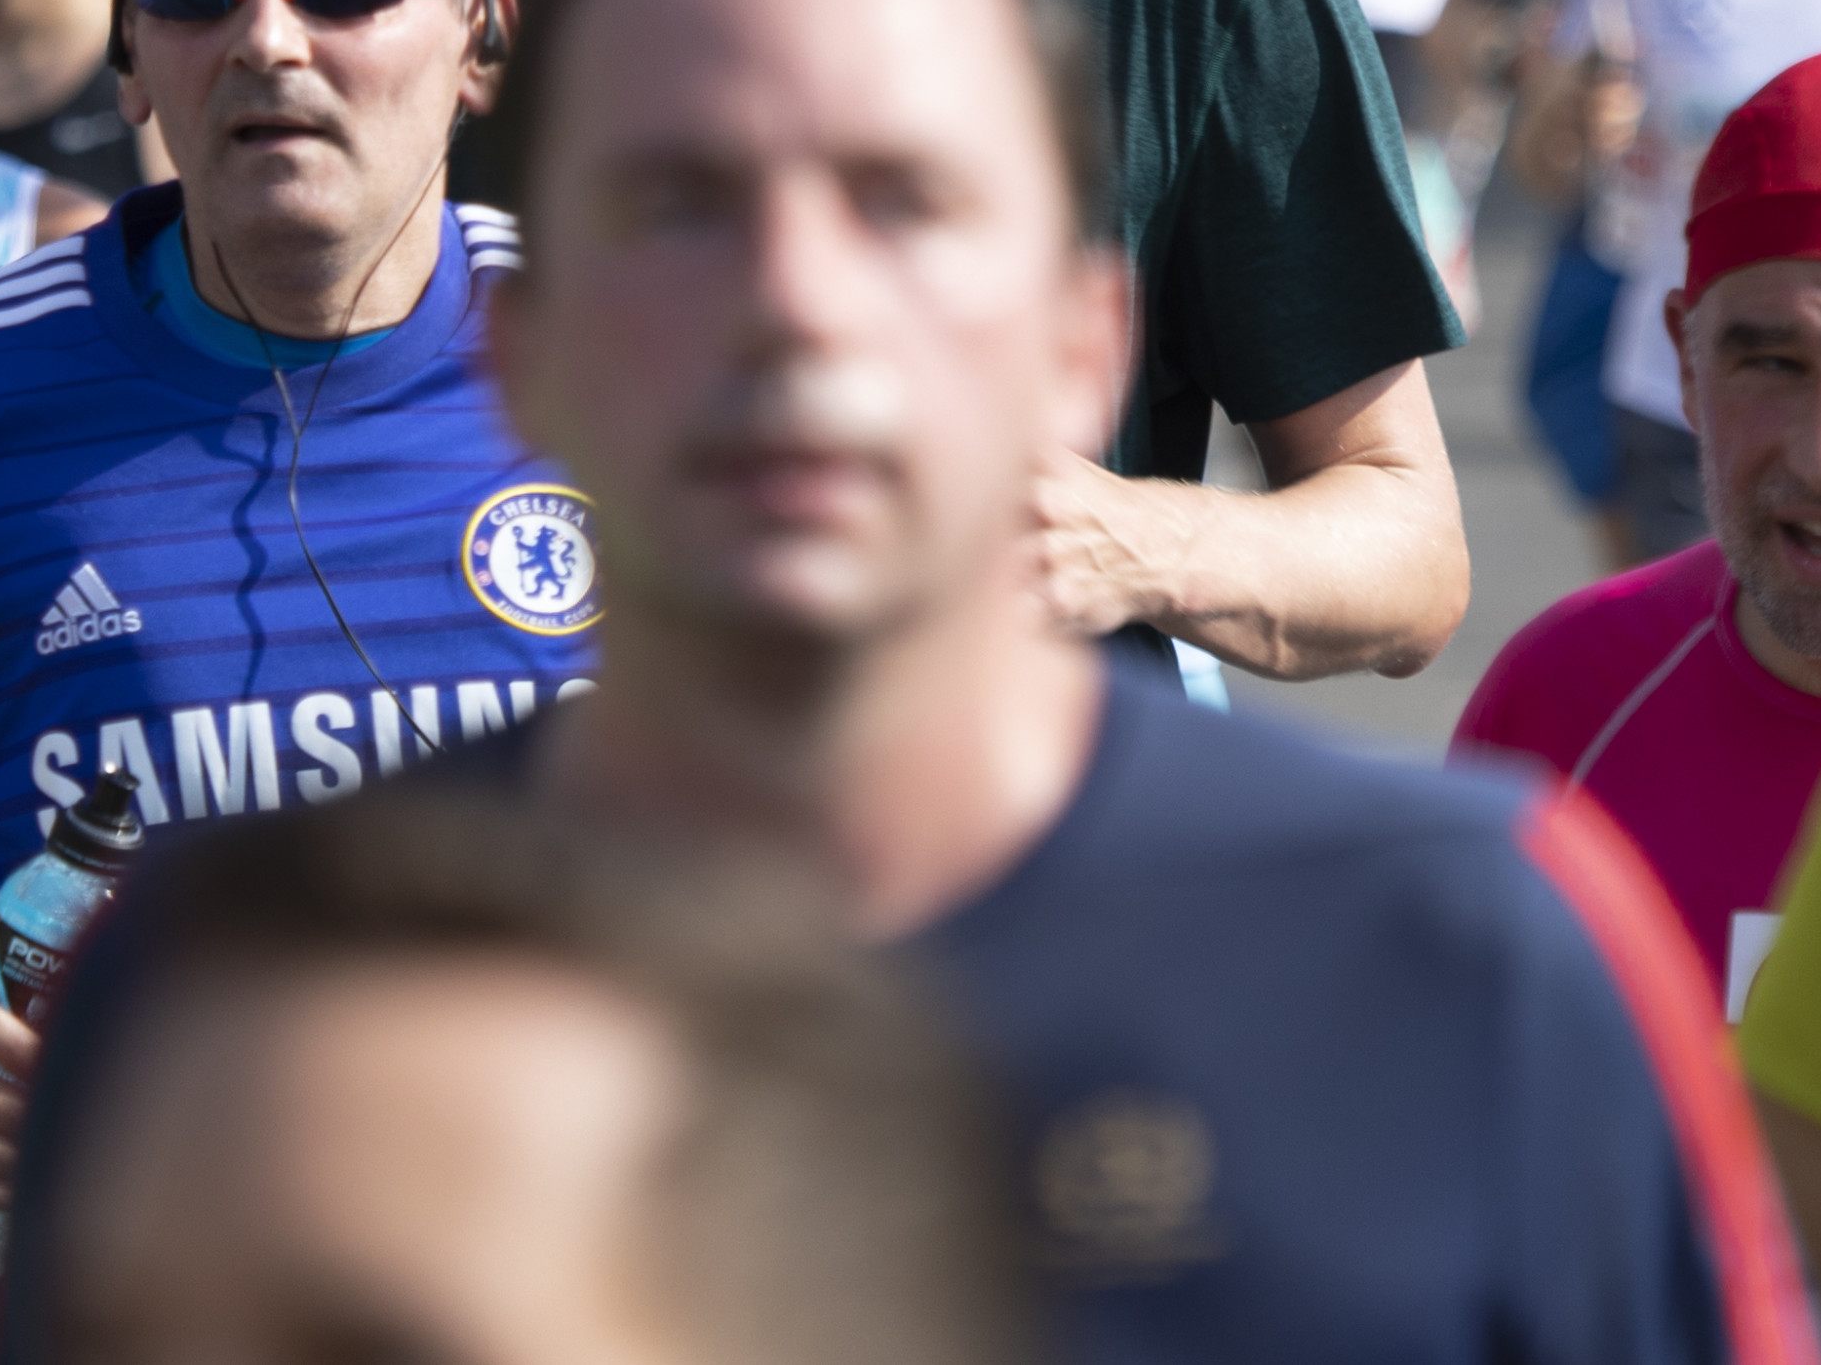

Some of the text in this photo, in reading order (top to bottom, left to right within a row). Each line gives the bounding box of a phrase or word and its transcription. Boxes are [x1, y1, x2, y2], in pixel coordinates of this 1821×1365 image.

[488, 497, 586, 528] CHELSEA
[36, 610, 142, 654] adidas
[32, 678, 600, 837] SAMSUN
